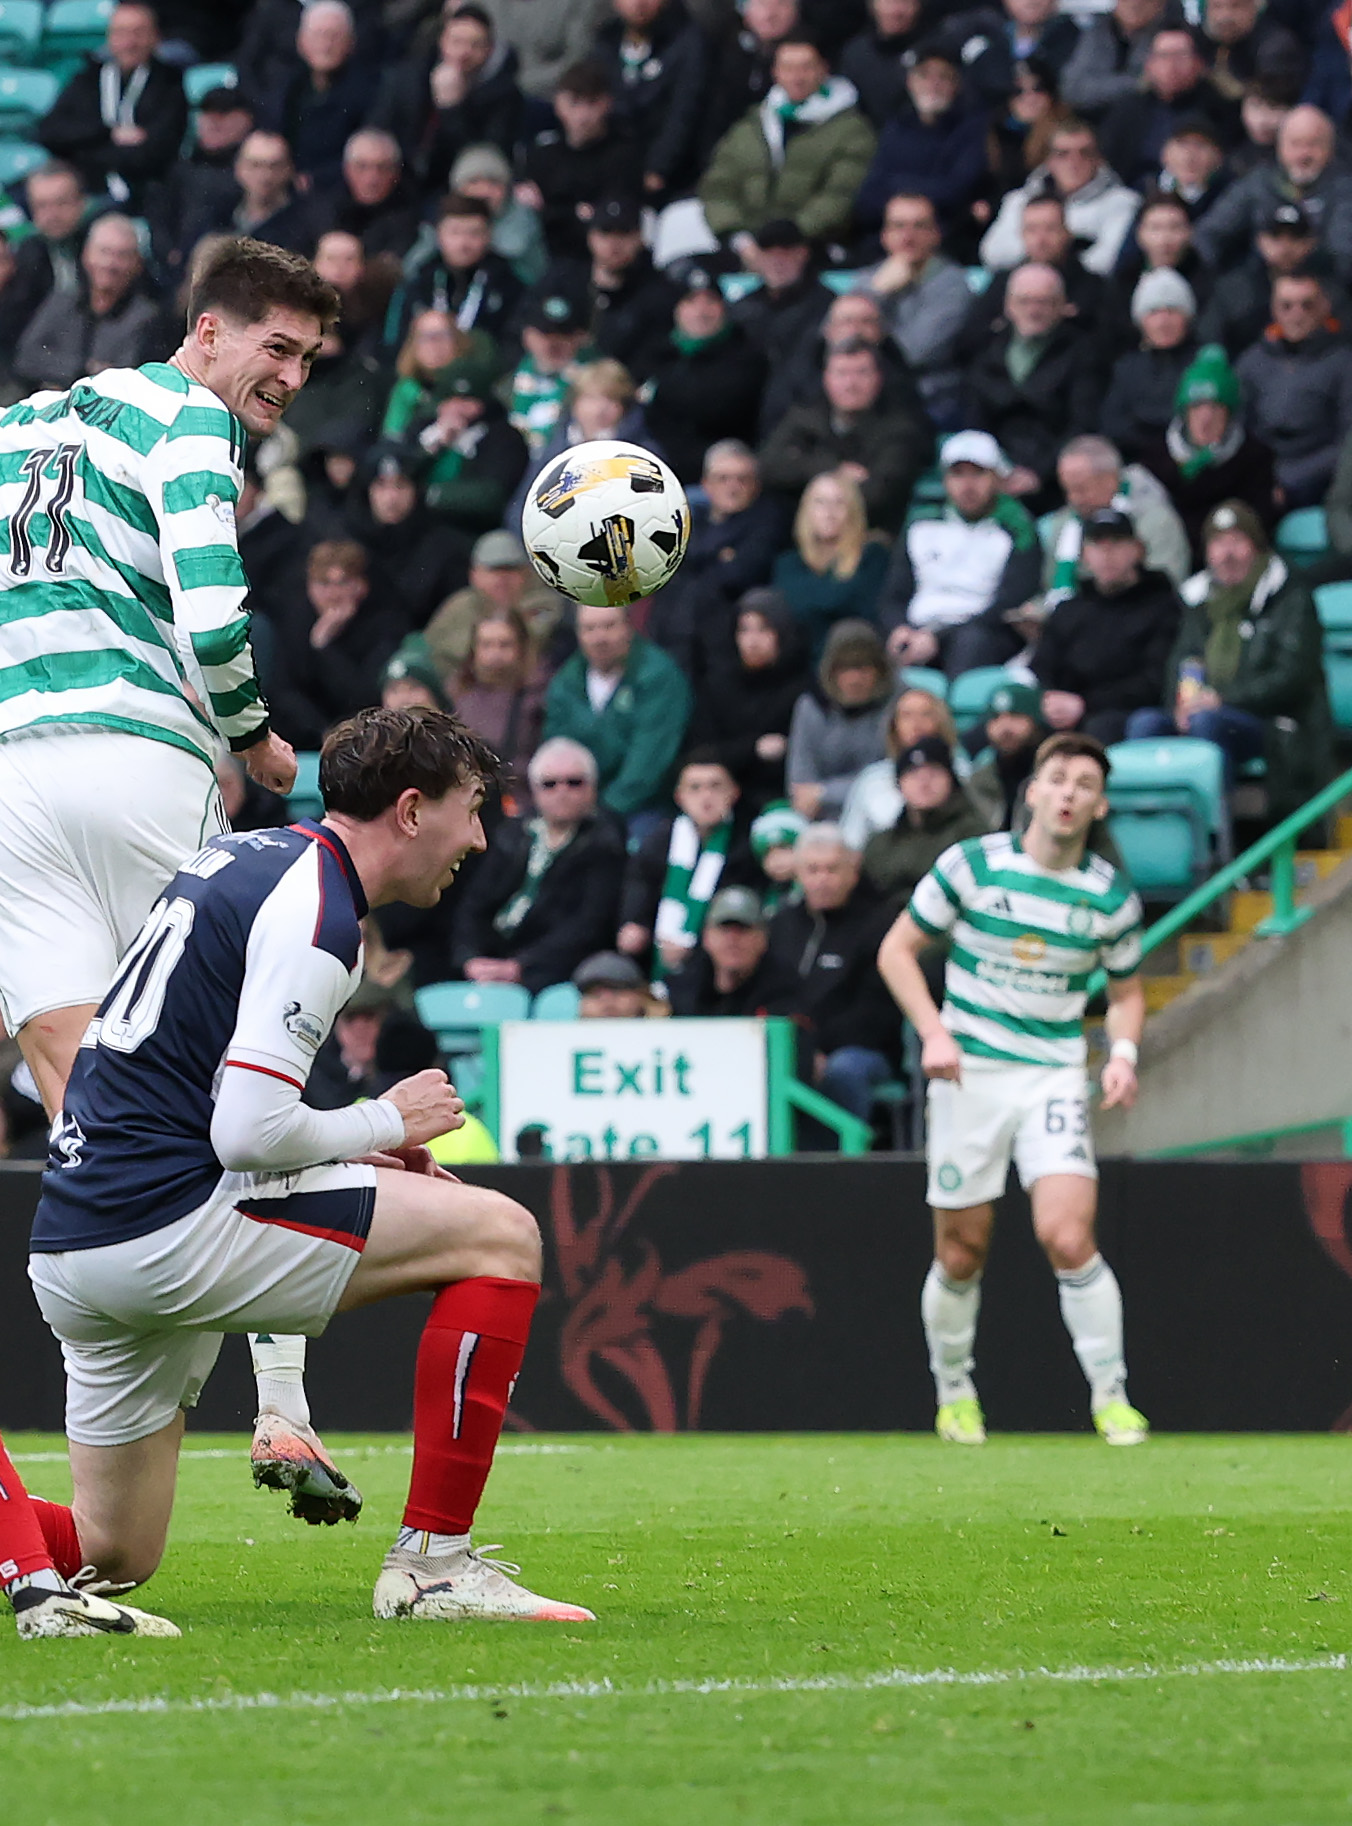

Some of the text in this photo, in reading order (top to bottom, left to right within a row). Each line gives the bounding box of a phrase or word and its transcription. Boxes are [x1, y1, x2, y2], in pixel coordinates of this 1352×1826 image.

[7, 441, 86, 577] 11
[571, 1047, 691, 1096] Exit
[689, 1119, 754, 1161] 11
[1045, 1099, 1087, 1136] 63
